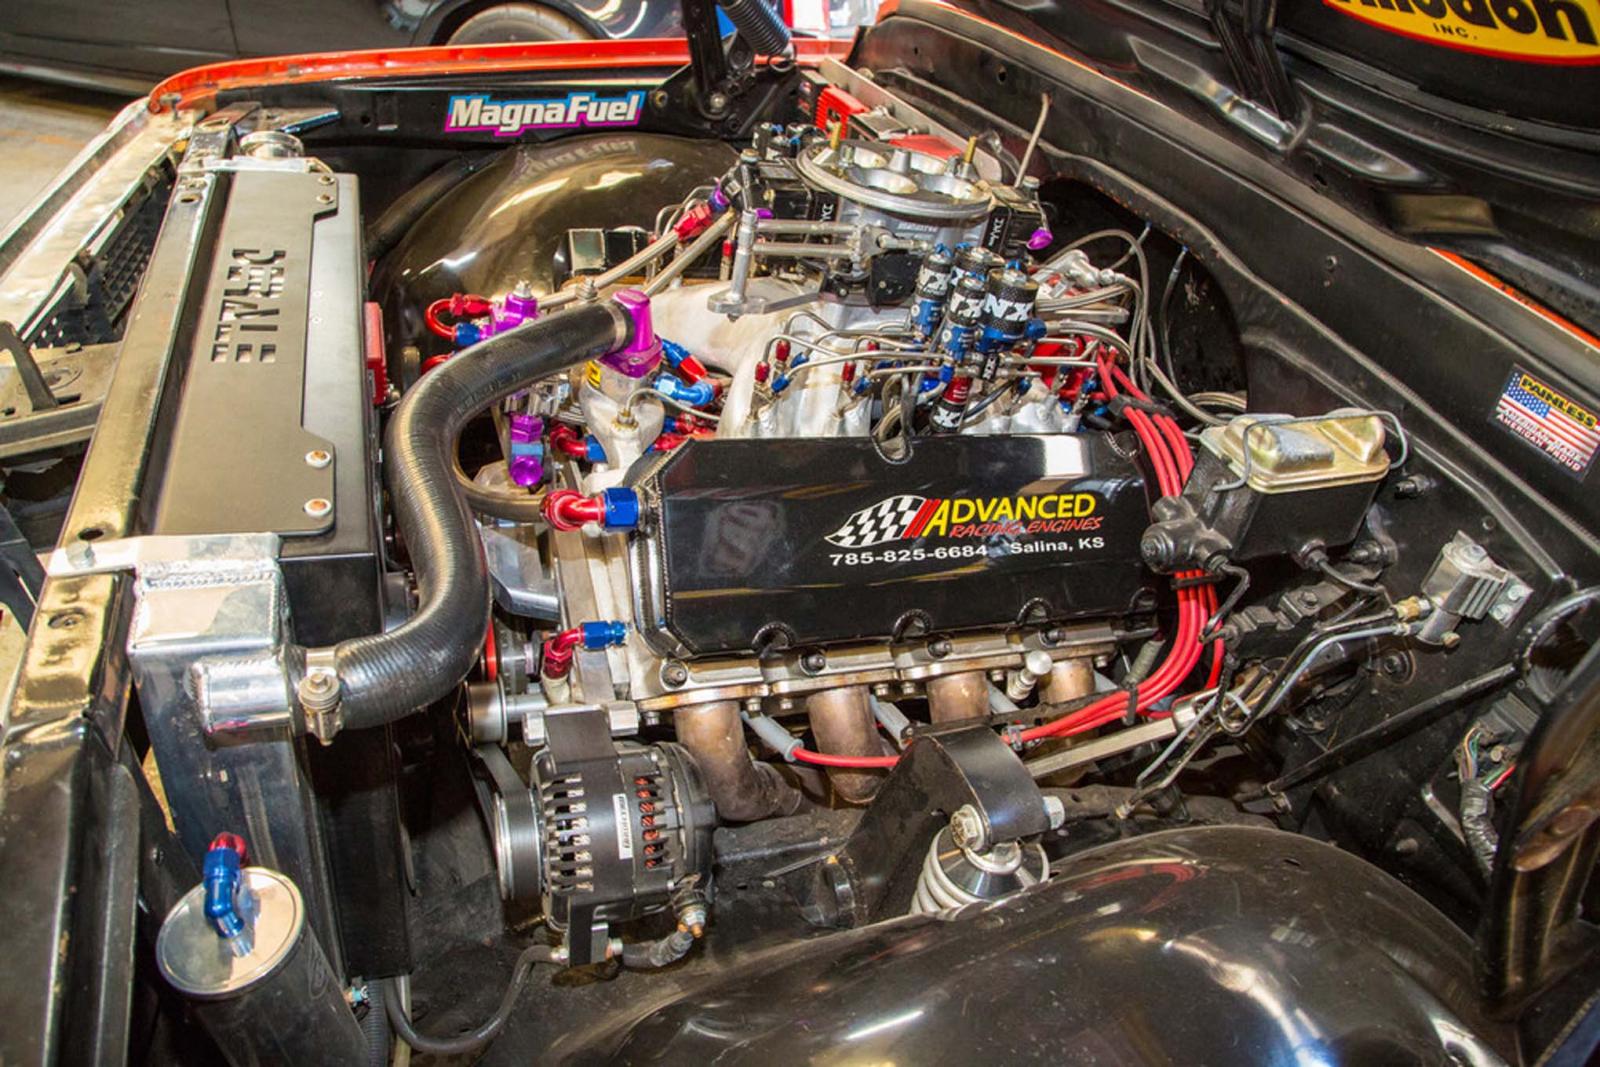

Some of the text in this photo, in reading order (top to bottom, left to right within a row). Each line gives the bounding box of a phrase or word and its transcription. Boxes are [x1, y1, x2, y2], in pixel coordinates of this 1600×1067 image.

[1433, 22, 1478, 40] INC.
[449, 93, 641, 132] MagnaFuel
[983, 293, 1035, 322] NX
[1520, 376, 1596, 428] PAINLESS
[922, 494, 1096, 536] ADVANCED
[949, 516, 1104, 538] RACING ENGINES
[828, 536, 1105, 567] 785-825-6684 Salina, KS
